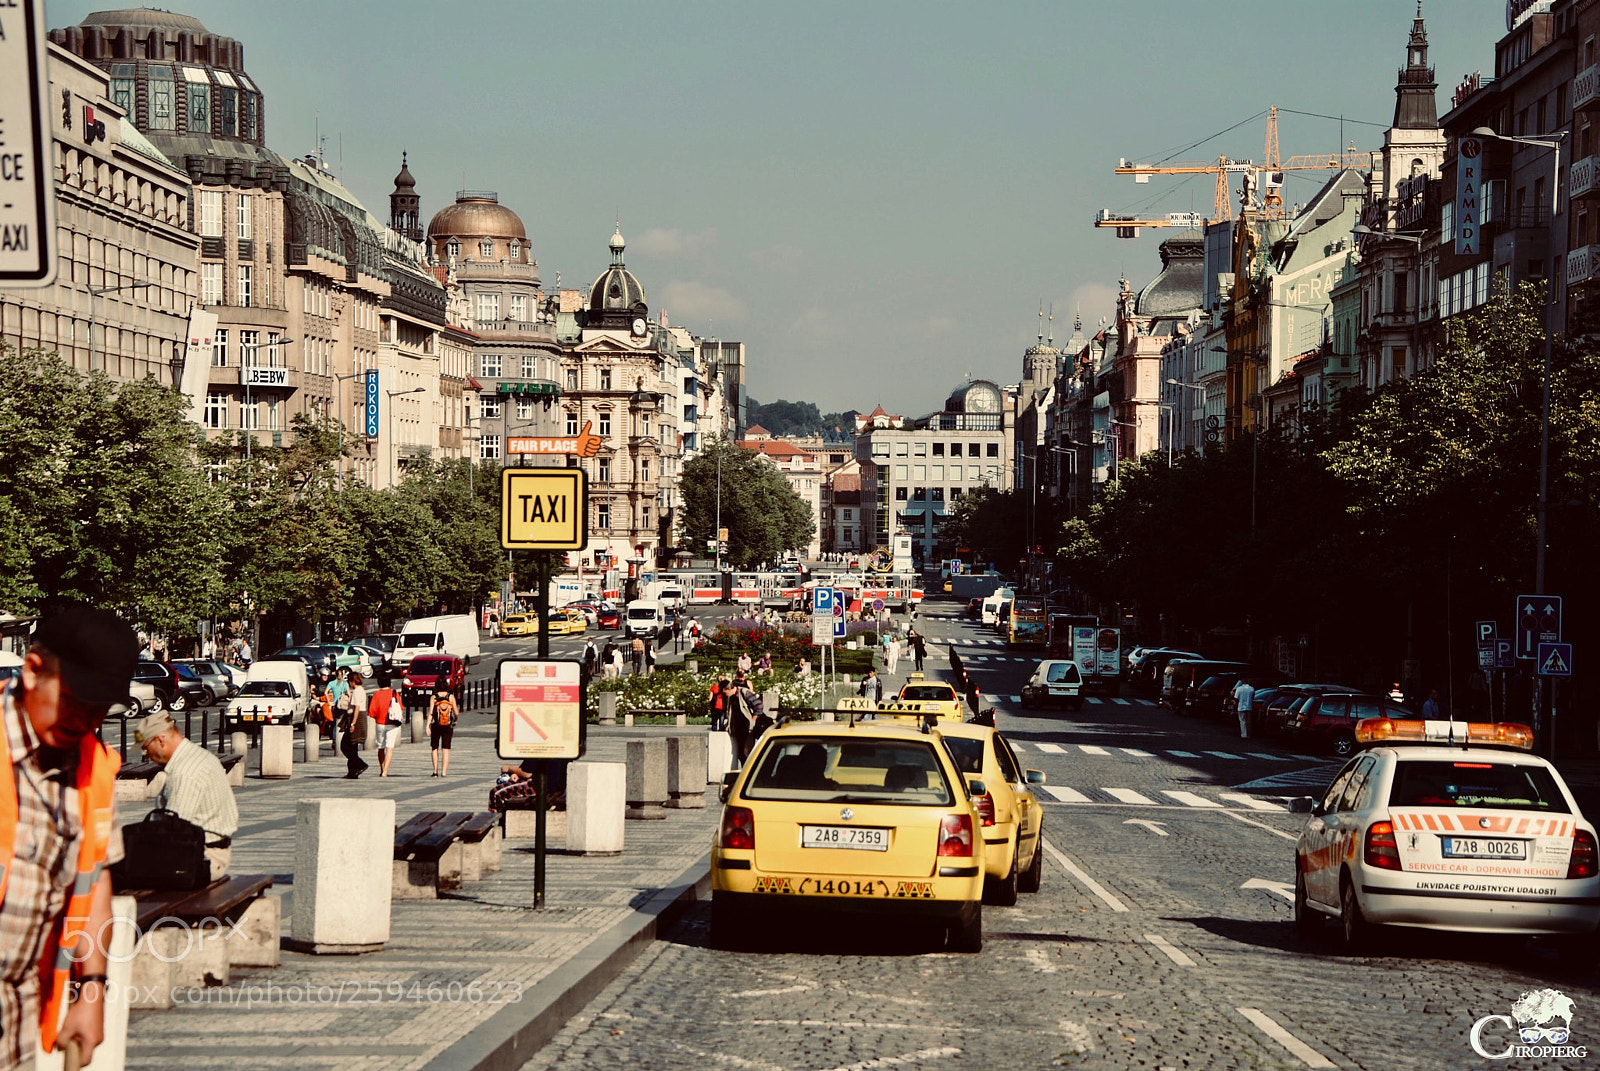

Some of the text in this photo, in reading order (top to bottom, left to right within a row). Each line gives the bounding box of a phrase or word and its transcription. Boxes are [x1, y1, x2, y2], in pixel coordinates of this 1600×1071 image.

[1462, 167, 1476, 254] RAMADA
[0, 224, 29, 252] AXI
[368, 373, 377, 436] ROKOKO
[510, 440, 578, 452] FAIR PLACE
[519, 495, 566, 523] TAXI
[817, 590, 830, 607] P
[1480, 624, 1493, 641] P
[1498, 642, 1511, 659] P
[842, 699, 870, 709] TAXI
[815, 828, 881, 844] 2A8 7359
[1454, 840, 1478, 854] 7A8
[1488, 841, 1519, 855] 0026
[1408, 862, 1447, 872] SERVICE
[1449, 864, 1468, 872] CAR
[1523, 868, 1560, 877] NEHODY
[752, 876, 936, 899] AAA 14014 AAA
[1416, 882, 1461, 891] LIKVIDACE
